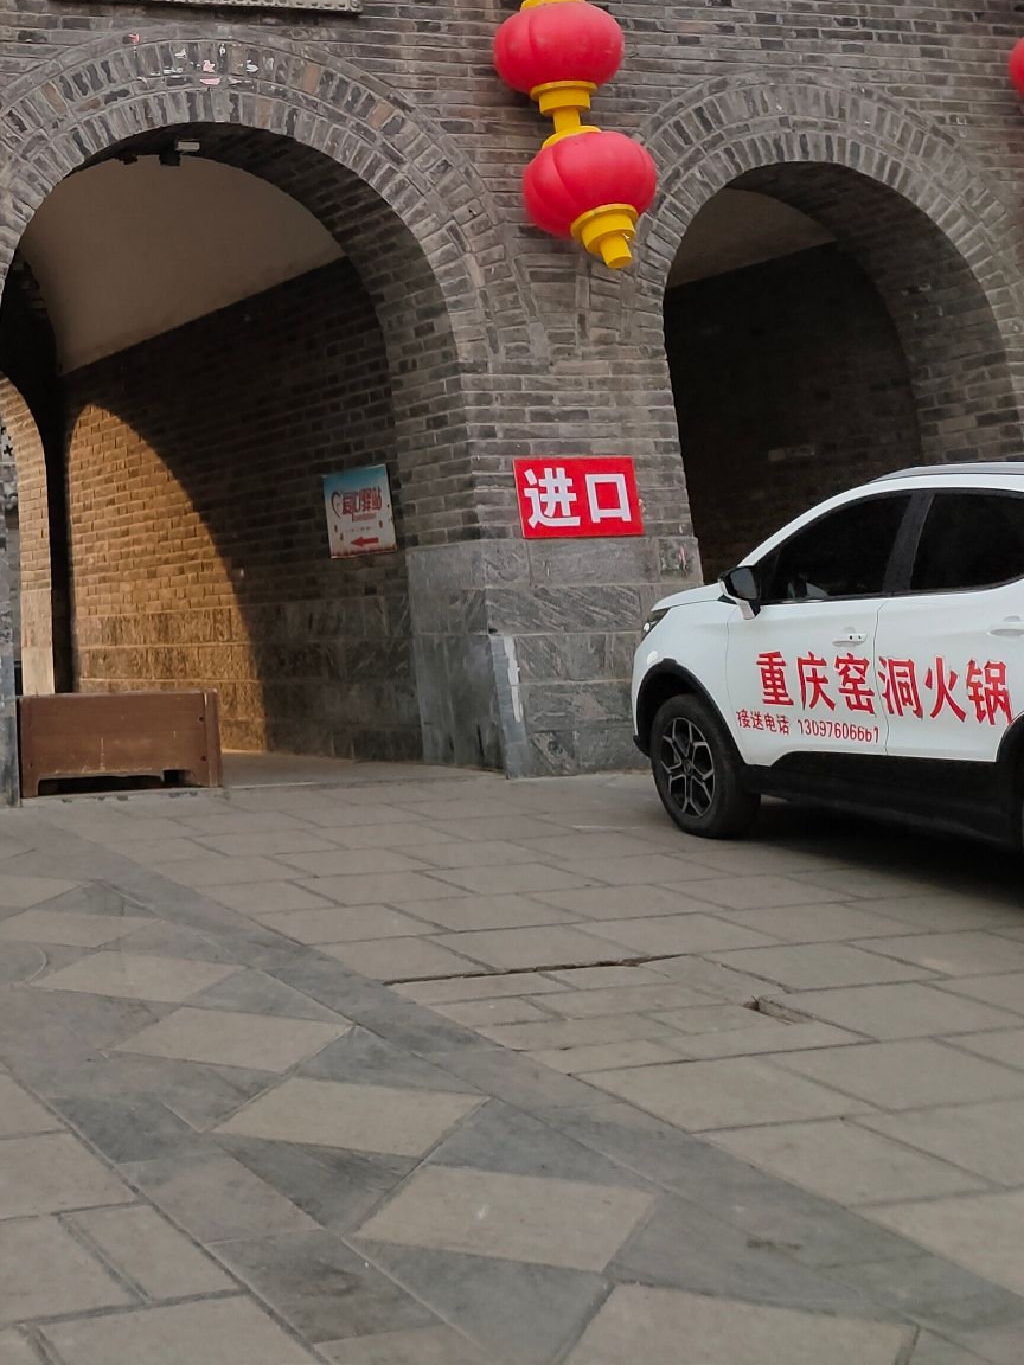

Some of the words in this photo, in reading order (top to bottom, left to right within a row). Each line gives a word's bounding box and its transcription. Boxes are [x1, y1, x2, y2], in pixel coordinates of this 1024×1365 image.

[524, 467, 631, 528] 进口
[756, 651, 1012, 726] 重庆窑洞火锅
[736, 709, 789, 735] 接送电话
